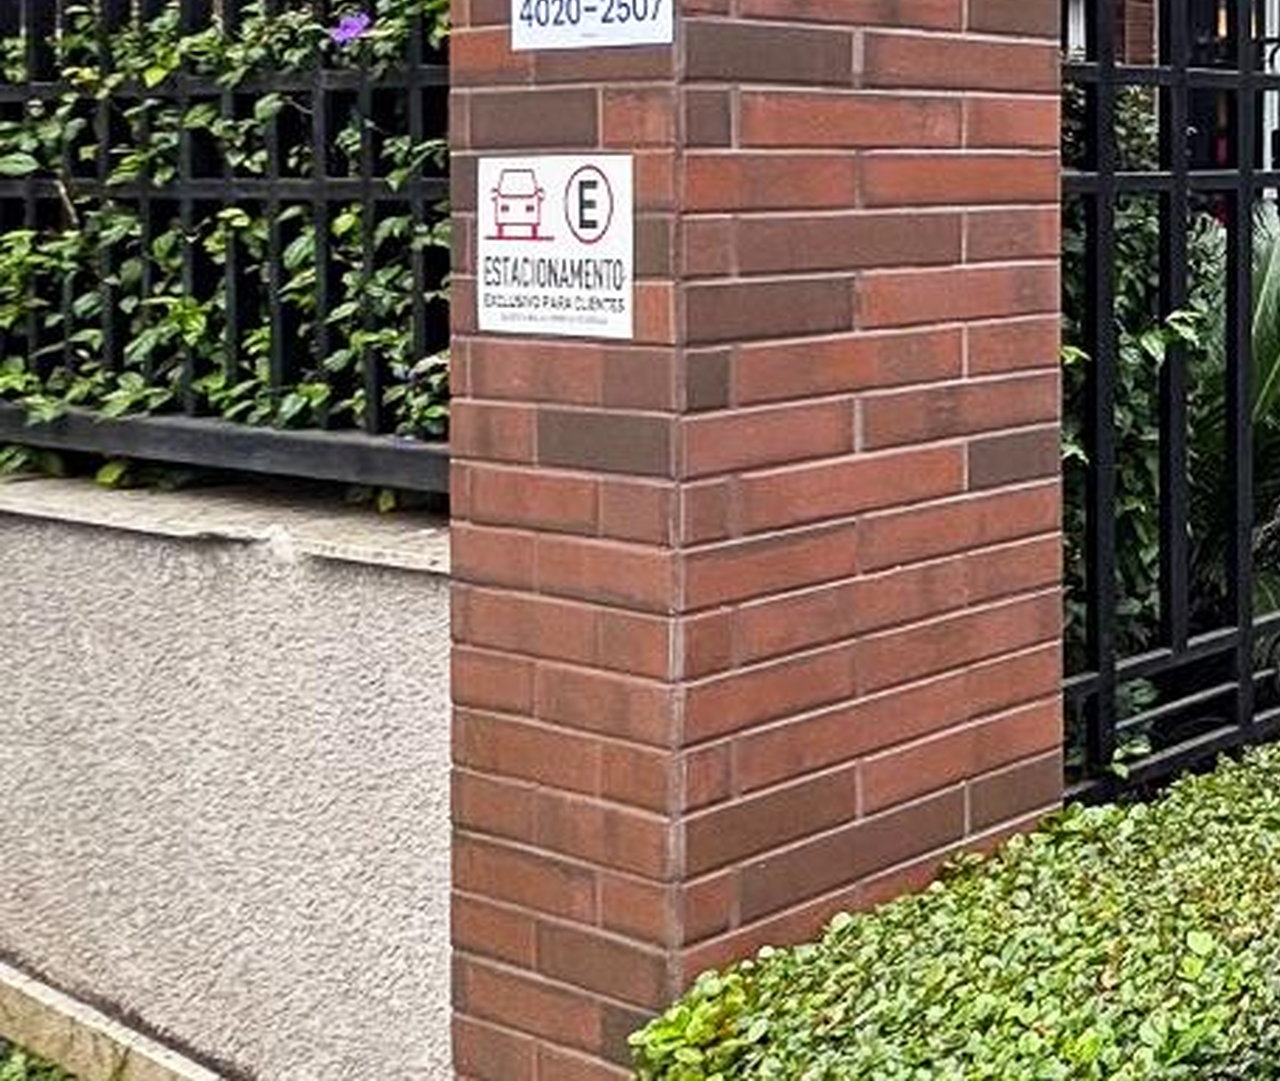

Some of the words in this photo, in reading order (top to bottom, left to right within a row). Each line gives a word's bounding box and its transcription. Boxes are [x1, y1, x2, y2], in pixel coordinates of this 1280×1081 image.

[578, 180, 599, 230] E
[483, 255, 624, 291] ESTACIONAMENTO
[542, 295, 572, 311] PARA
[575, 295, 625, 314] CLIENTES
